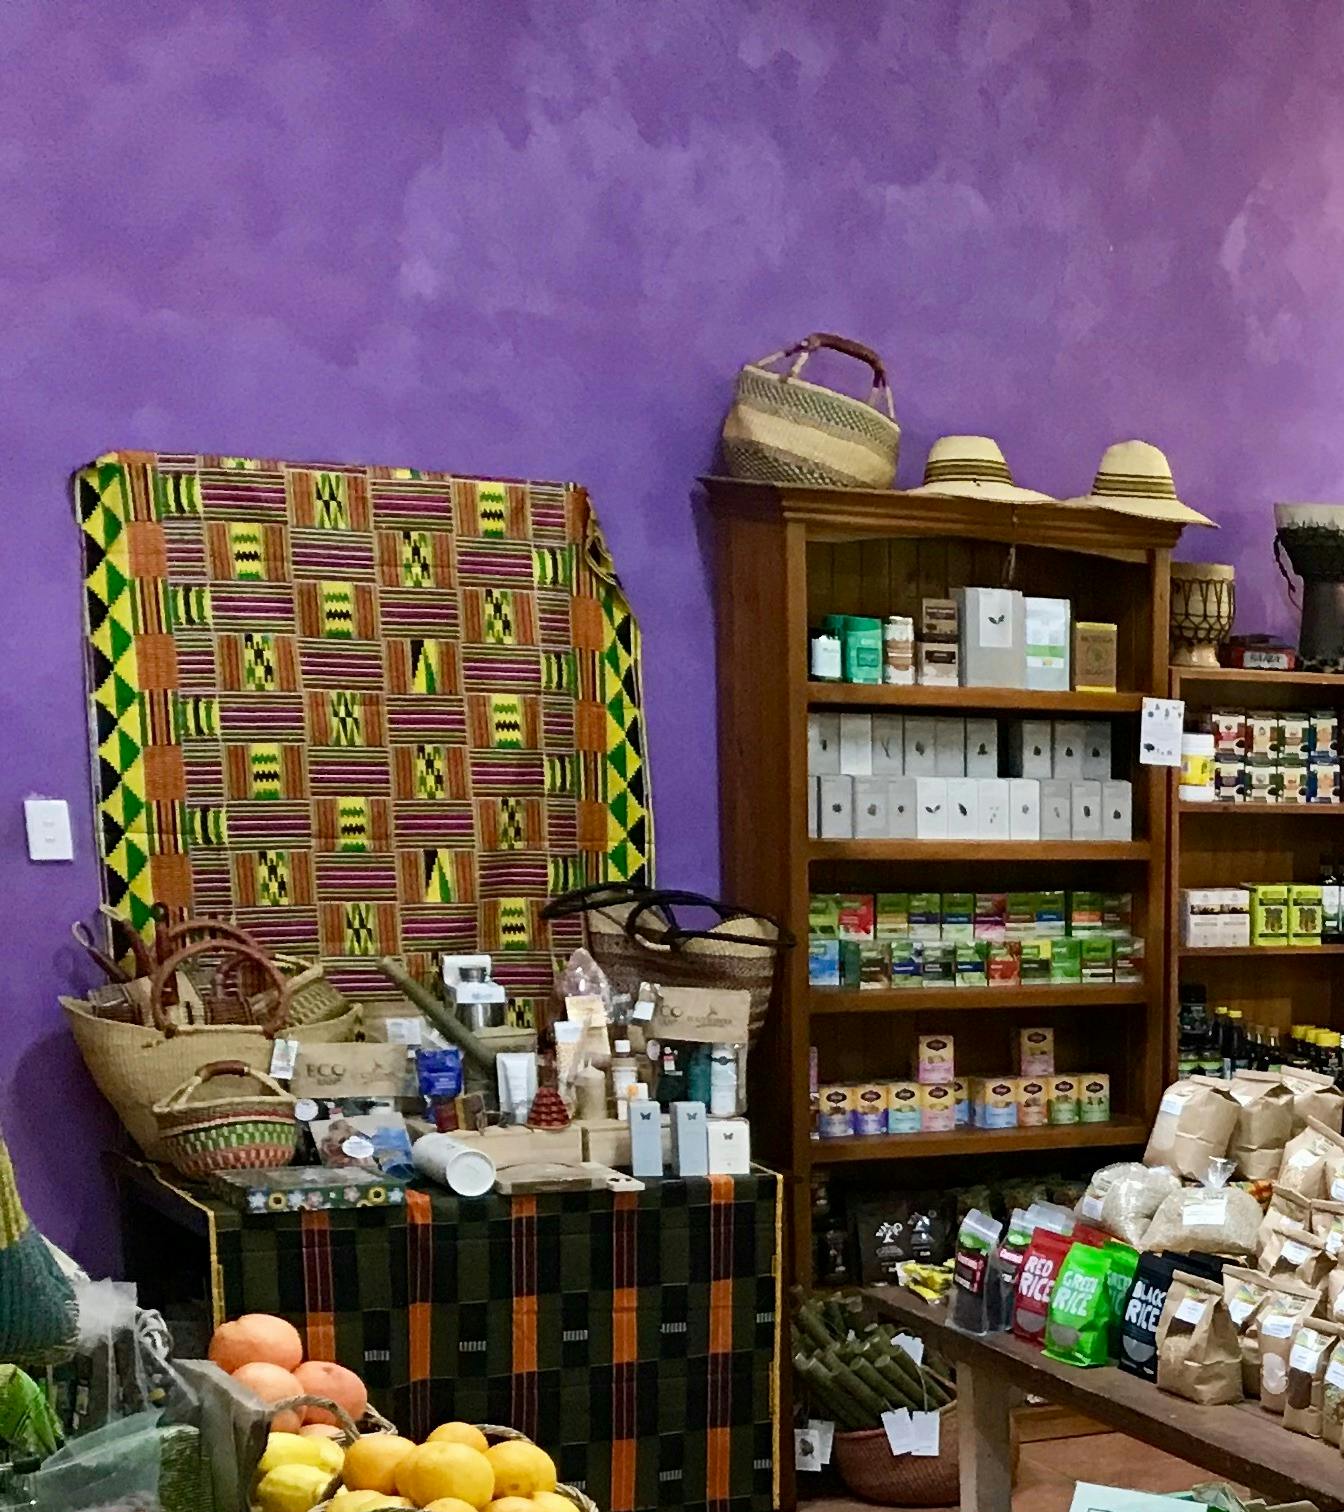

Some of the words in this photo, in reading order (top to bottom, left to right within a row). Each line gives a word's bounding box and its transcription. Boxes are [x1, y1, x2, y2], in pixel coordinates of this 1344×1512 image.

[1024, 1255, 1054, 1278] RED
[1018, 1272, 1055, 1303] RICE
[1062, 1270, 1099, 1294] GREEN
[1132, 1281, 1167, 1307] BLACK
[1052, 1287, 1093, 1317] RICE
[1124, 1299, 1161, 1332] RICE
